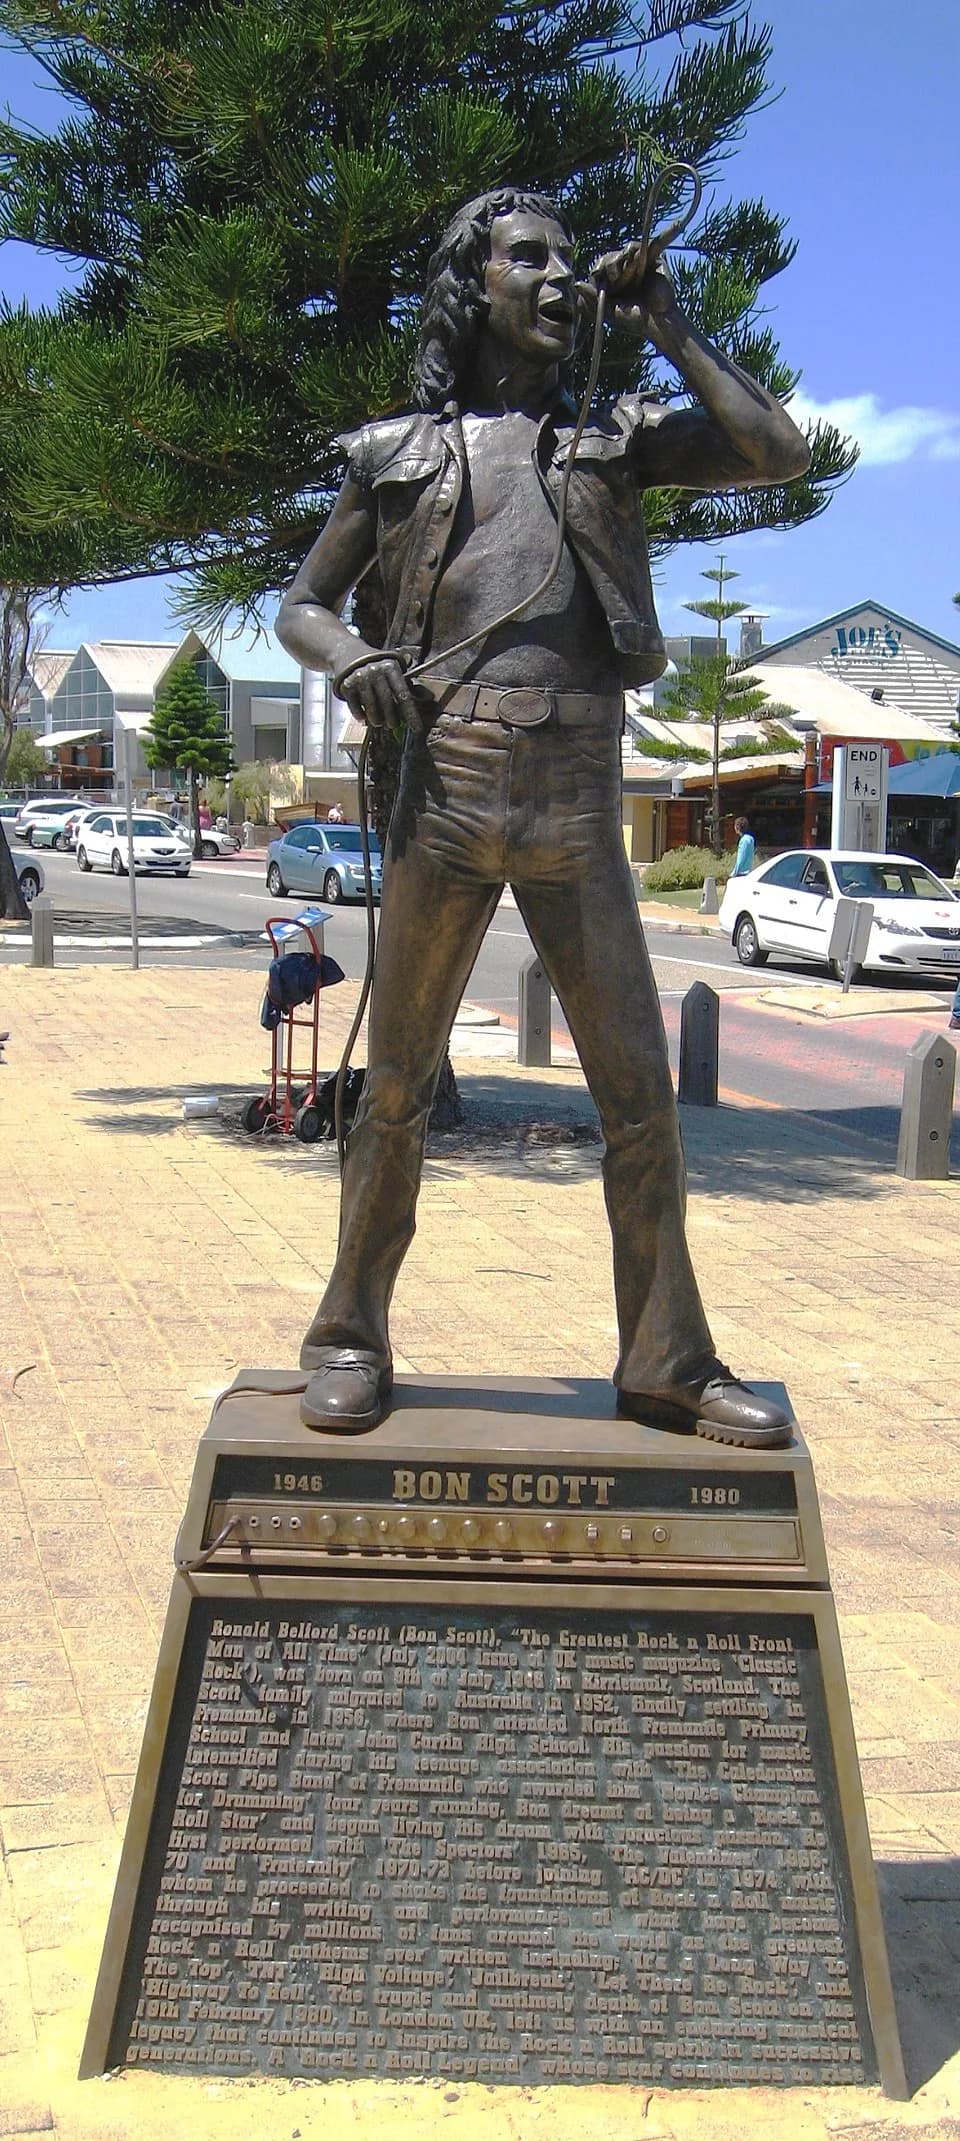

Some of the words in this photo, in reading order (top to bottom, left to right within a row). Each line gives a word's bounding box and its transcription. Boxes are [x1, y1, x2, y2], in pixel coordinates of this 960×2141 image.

[831, 625, 901, 657] JOE'S
[851, 751, 877, 761] END
[274, 1473, 323, 1492] 1946
[392, 1470, 471, 1500] BON
[487, 1472, 616, 1505] SCOTT
[690, 1487, 740, 1505] 1980
[212, 1620, 270, 1637] Ronald
[278, 1622, 338, 1639] Belford
[348, 1624, 390, 1640] Scott
[400, 1625, 436, 1644] (Bon
[446, 1626, 501, 1647] Scott),
[512, 1628, 550, 1645] “The
[206, 1641, 243, 1658] Man
[255, 1643, 272, 1658] of
[283, 1643, 308, 1659] All
[319, 1644, 367, 1661] Time”
[377, 1646, 418, 1666] (July
[553, 1651, 576, 1667] UK
[273, 1667, 305, 1681] was
[315, 1665, 353, 1682] born
[362, 1670, 384, 1683] on
[395, 1668, 420, 1684] 9th
[431, 1669, 448, 1685] of
[458, 1669, 493, 1689] July
[200, 1683, 241, 1700] Scott
[259, 1685, 312, 1705] family
[329, 1687, 404, 1707] migrated
[421, 1690, 437, 1706] to
[455, 1691, 532, 1709] Australia
[194, 1704, 276, 1723] Fremantle
[292, 1707, 308, 1723] in
[384, 1710, 434, 1727] where
[448, 1712, 480, 1728] Bon
[493, 1713, 568, 1731] attended
[191, 1725, 246, 1743] School
[257, 1728, 290, 1744] and
[302, 1729, 344, 1746] later
[357, 1730, 398, 1747] John
[411, 1732, 463, 1749] Curtin
[476, 1734, 515, 1754] High
[185, 1746, 278, 1765] intensified
[295, 1750, 353, 1770] during
[368, 1752, 396, 1769] his
[415, 1753, 479, 1774] teenage
[495, 1757, 596, 1775] association
[181, 1768, 228, 1785] Scots
[240, 1769, 277, 1789] Pipe
[350, 1773, 367, 1789] of
[378, 1773, 463, 1792] Fremantle
[474, 1777, 509, 1793] who
[522, 1779, 595, 1796] awarded
[176, 1789, 202, 1806] for
[213, 1790, 311, 1811] Drumming'
[324, 1793, 362, 1810] four
[370, 1798, 418, 1814] years
[516, 1799, 549, 1816] Bon
[172, 1810, 208, 1827] Roll
[221, 1811, 266, 1829] Star'
[280, 1814, 315, 1830] and
[325, 1814, 380, 1835] began
[392, 1816, 443, 1837] living
[456, 1818, 482, 1835] his
[496, 1819, 550, 1837] dream
[168, 1831, 207, 1848] first
[220, 1833, 312, 1852] performed
[326, 1836, 364, 1853] with
[436, 1839, 519, 1859] Spectors'
[164, 1852, 189, 1869] 70
[203, 1854, 236, 1871] and
[464, 1861, 522, 1879] before
[160, 1873, 213, 1891] whom
[224, 1875, 247, 1892] he
[257, 1878, 351, 1896] proceeded
[363, 1879, 382, 1896] to
[391, 1880, 446, 1898] shake
[461, 1882, 487, 1900] the
[156, 1894, 229, 1916] through
[252, 1897, 280, 1914] his
[304, 1899, 372, 1920] writing
[394, 1902, 429, 1919] and
[452, 1904, 570, 1923] performance
[267, 1919, 290, 1939] by
[305, 1920, 382, 1939] millions
[431, 1924, 472, 1942] fans
[486, 1927, 554, 1944] around
[570, 1928, 599, 1946] the
[147, 1936, 193, 1954] Rock
[235, 1939, 274, 1957] Roll
[289, 1941, 368, 1960] anthems
[384, 1947, 424, 1962] ever
[439, 1946, 508, 1964] written
[144, 1957, 177, 1975] The
[239, 1982, 260, 1999] To
[328, 1984, 364, 2002] The
[375, 1986, 432, 2007] tragic
[442, 1989, 478, 2006] and
[490, 1990, 574, 2012] untimely
[136, 1999, 180, 2018] 19th
[188, 2001, 274, 2024] February
[349, 2006, 369, 2024] in
[378, 2007, 452, 2027] London
[461, 2010, 497, 2031] UK,
[507, 2011, 541, 2029] left
[552, 2016, 575, 2031] us
[130, 2020, 197, 2043] legacy
[206, 2023, 247, 2041] that
[257, 2026, 356, 2045] continues
[368, 2028, 386, 2046] to
[396, 2029, 469, 2051] inspire
[479, 2032, 511, 2050] the
[519, 2033, 571, 2052] Rock
[270, 2046, 284, 2064] A
[385, 2050, 431, 2069] Roll
